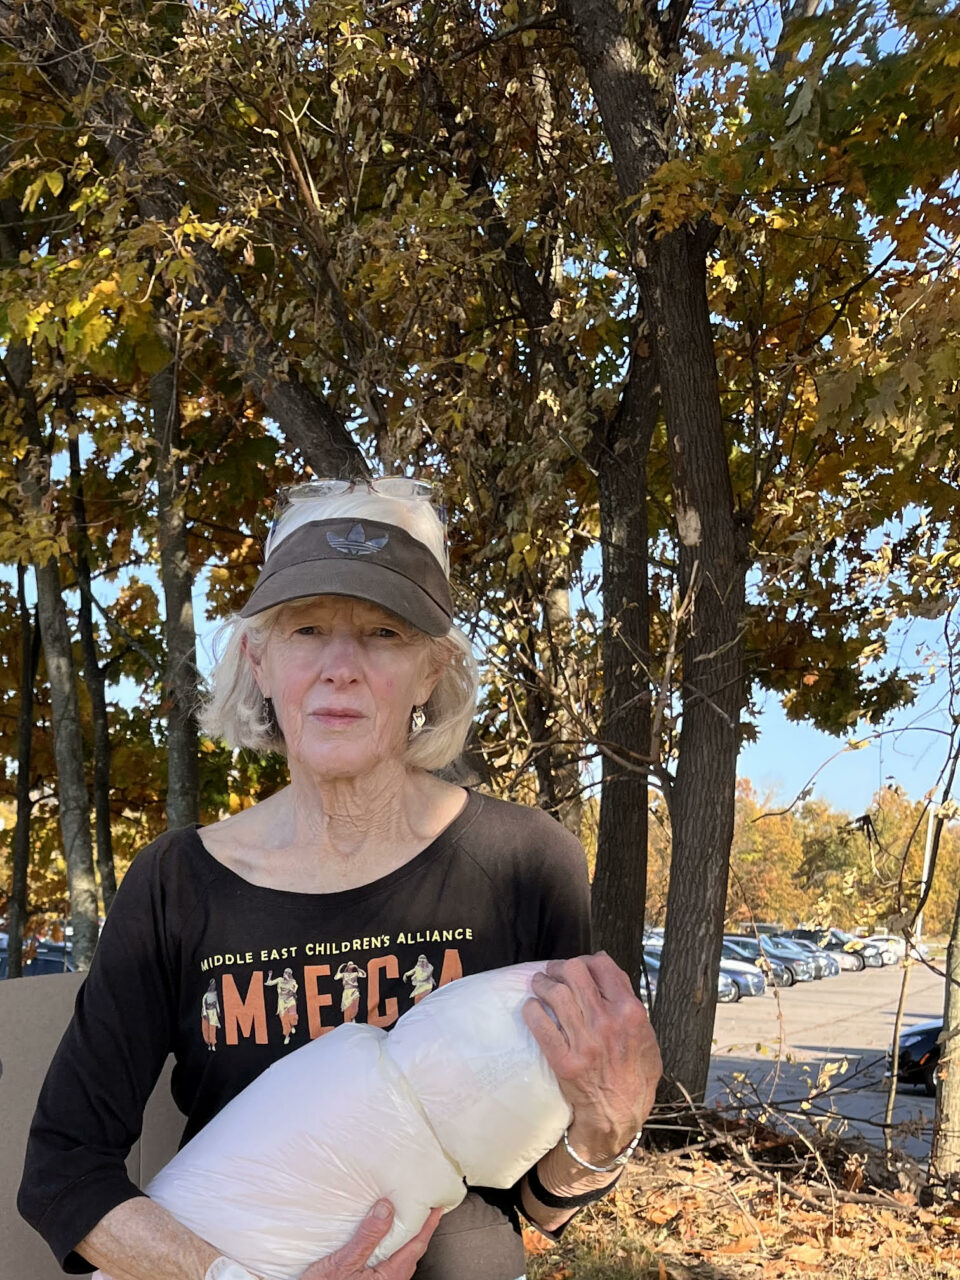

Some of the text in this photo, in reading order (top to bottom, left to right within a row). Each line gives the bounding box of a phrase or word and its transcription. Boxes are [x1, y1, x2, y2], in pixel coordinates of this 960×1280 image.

[200, 928, 473, 972] MIDDLE EAST CHILDREN'S ALLIANCE
